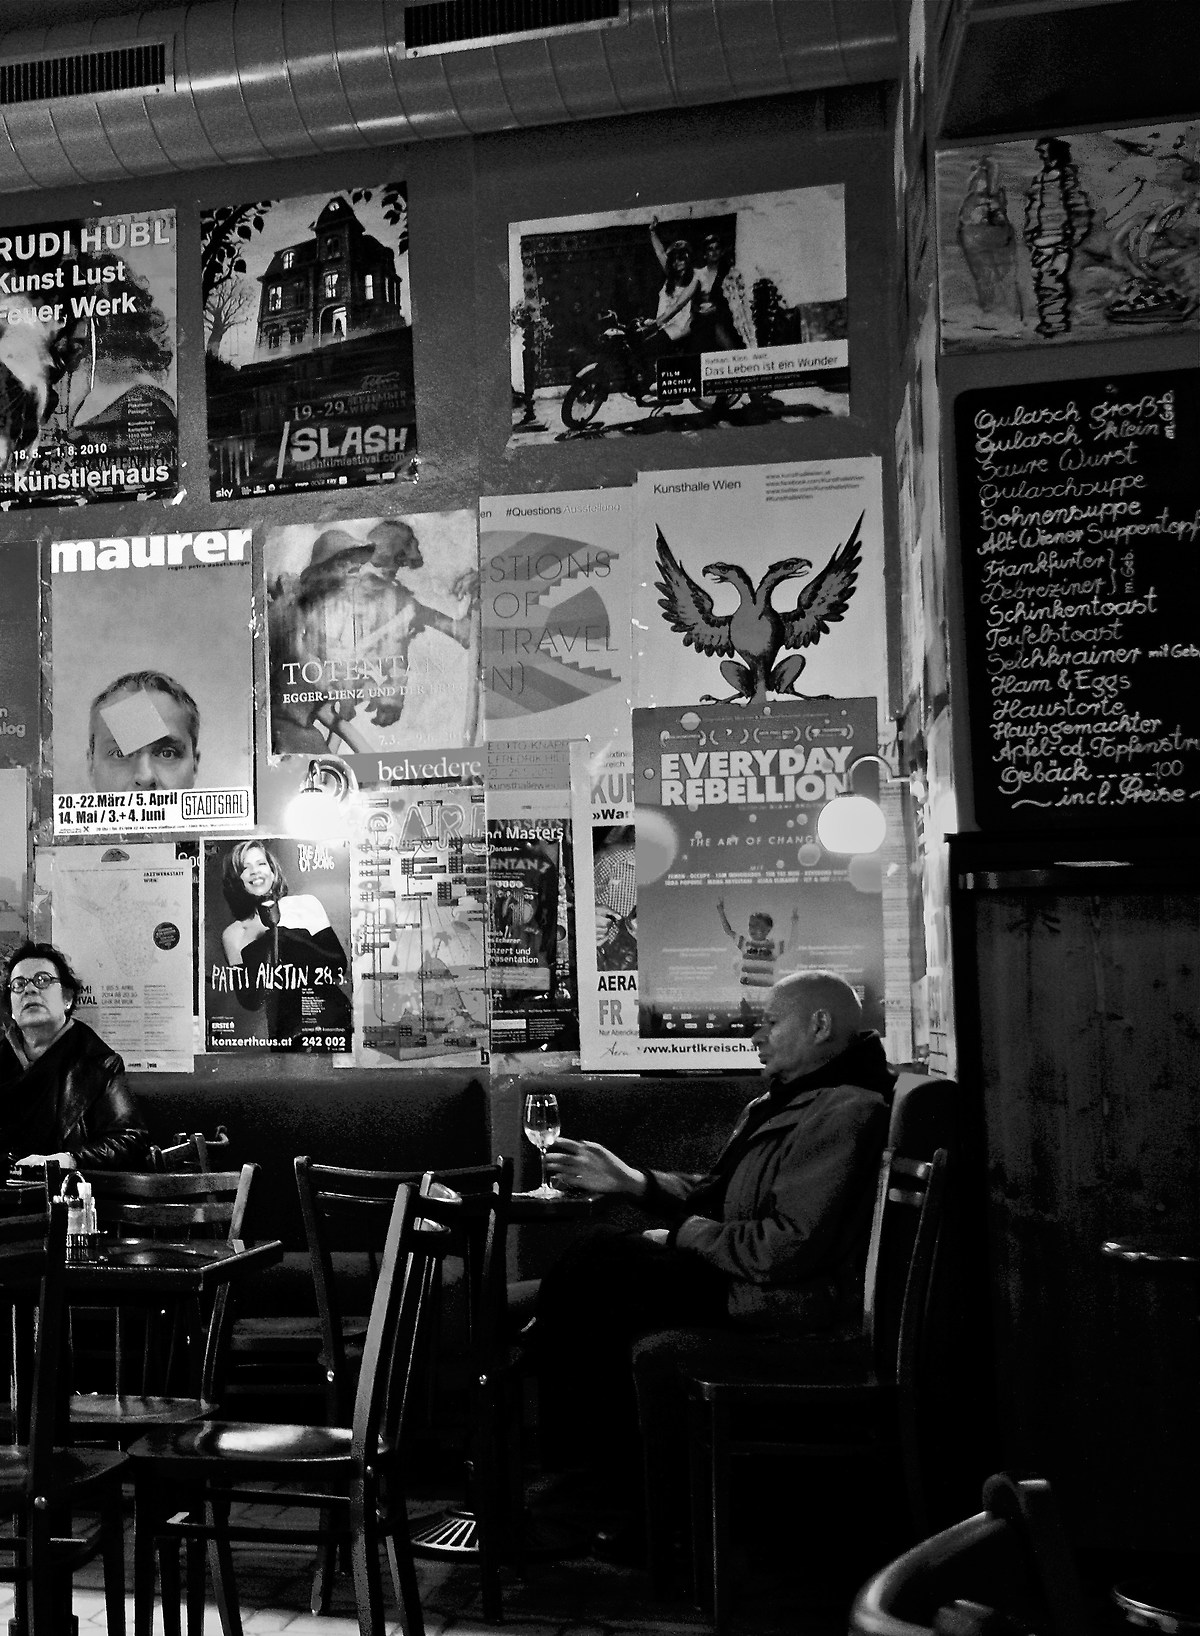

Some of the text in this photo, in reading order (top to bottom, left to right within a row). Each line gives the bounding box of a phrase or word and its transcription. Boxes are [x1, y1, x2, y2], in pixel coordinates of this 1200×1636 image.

[81, 218, 170, 253] HÜBL
[72, 261, 126, 286] Lust
[71, 292, 137, 318] Werk
[705, 366, 724, 377] Das
[728, 363, 760, 375] Leben
[763, 361, 774, 371] ist
[778, 359, 794, 369] ein
[799, 356, 838, 368] Wunder
[974, 396, 1157, 438] Gulasch groß
[81, 443, 107, 454] 2010
[975, 420, 1159, 463] Gulasch klein
[1059, 441, 1139, 471] Wurst
[14, 464, 170, 493] künstlerhaus
[653, 480, 742, 495] Kunsthalle Wien
[979, 474, 1147, 507] Gulaschsuppe
[216, 487, 233, 499] sky
[506, 505, 561, 517] #Questions
[980, 501, 1141, 531] Bohnensuppe
[50, 528, 253, 574] maurer
[982, 548, 1105, 583] Frankfurter
[493, 590, 538, 619] OF
[981, 578, 1106, 604] Debreziner
[986, 587, 1157, 627] Schinkentoast
[496, 626, 619, 654] TRAVEL
[986, 618, 1123, 651] Teufelstoast
[283, 689, 364, 704] EGGER-LIENZ
[369, 687, 395, 698] UND
[991, 675, 1050, 697] Ham
[1075, 669, 1132, 698] Eggs
[992, 692, 1126, 720] Haustorte
[990, 711, 1162, 745] Hausgemachter
[378, 757, 481, 781] belvedere
[660, 746, 853, 779] EVERYDAY
[998, 758, 1092, 794] Gebäck
[150, 792, 178, 806] April
[661, 772, 848, 806] REBELLION
[1116, 776, 1185, 804] Preise
[59, 811, 74, 824] 14.
[77, 810, 97, 823] Mai
[141, 808, 165, 821] Juni
[185, 794, 244, 816] STADTSAAL
[506, 827, 563, 840] Masters
[690, 835, 819, 847] THE ART OF CHANG
[313, 856, 335, 870] SONG
[516, 947, 531, 955] und
[212, 962, 347, 993] PATTI AUSTIN 28.3.
[597, 975, 637, 992] AERA
[212, 1036, 346, 1047] konzerthaus.at 242 002
